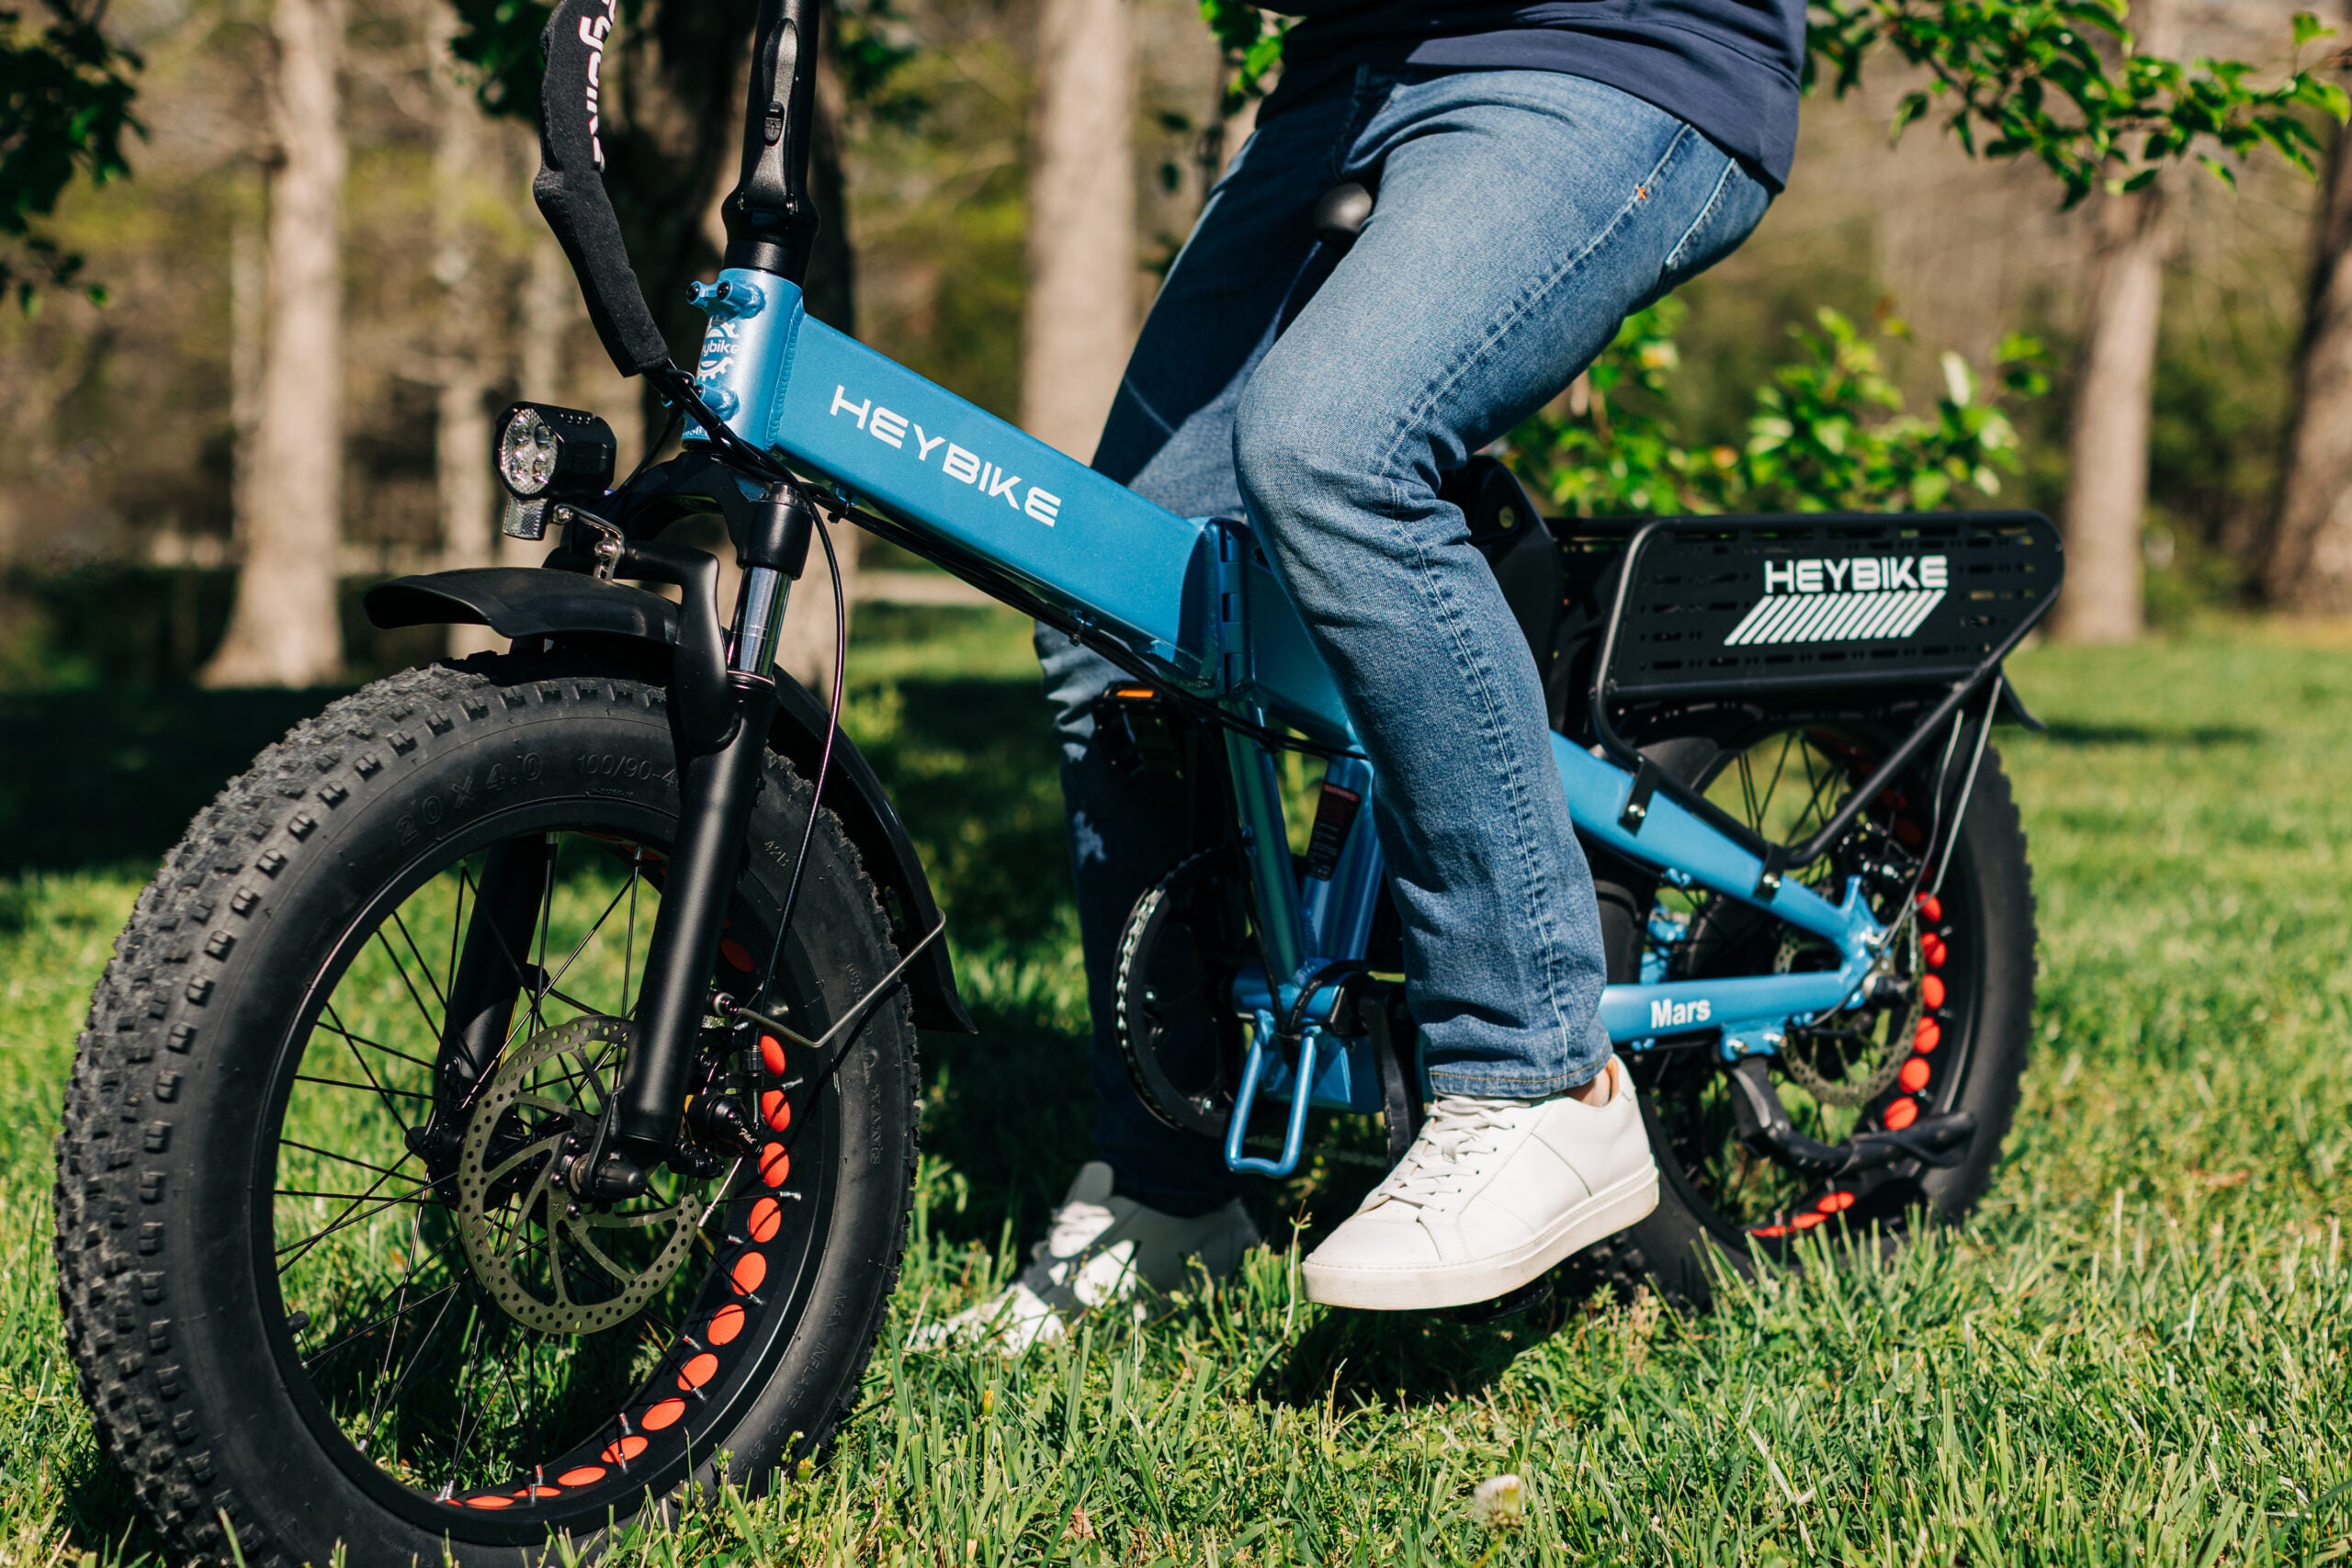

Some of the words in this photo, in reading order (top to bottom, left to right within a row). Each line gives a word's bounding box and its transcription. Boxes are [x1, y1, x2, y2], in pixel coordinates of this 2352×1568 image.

[830, 384, 1061, 528] HEYBIKE
[1764, 555, 1949, 593] HEYBIKE
[577, 754, 679, 791] 100/90-4
[1650, 998, 1712, 1029] Mars
